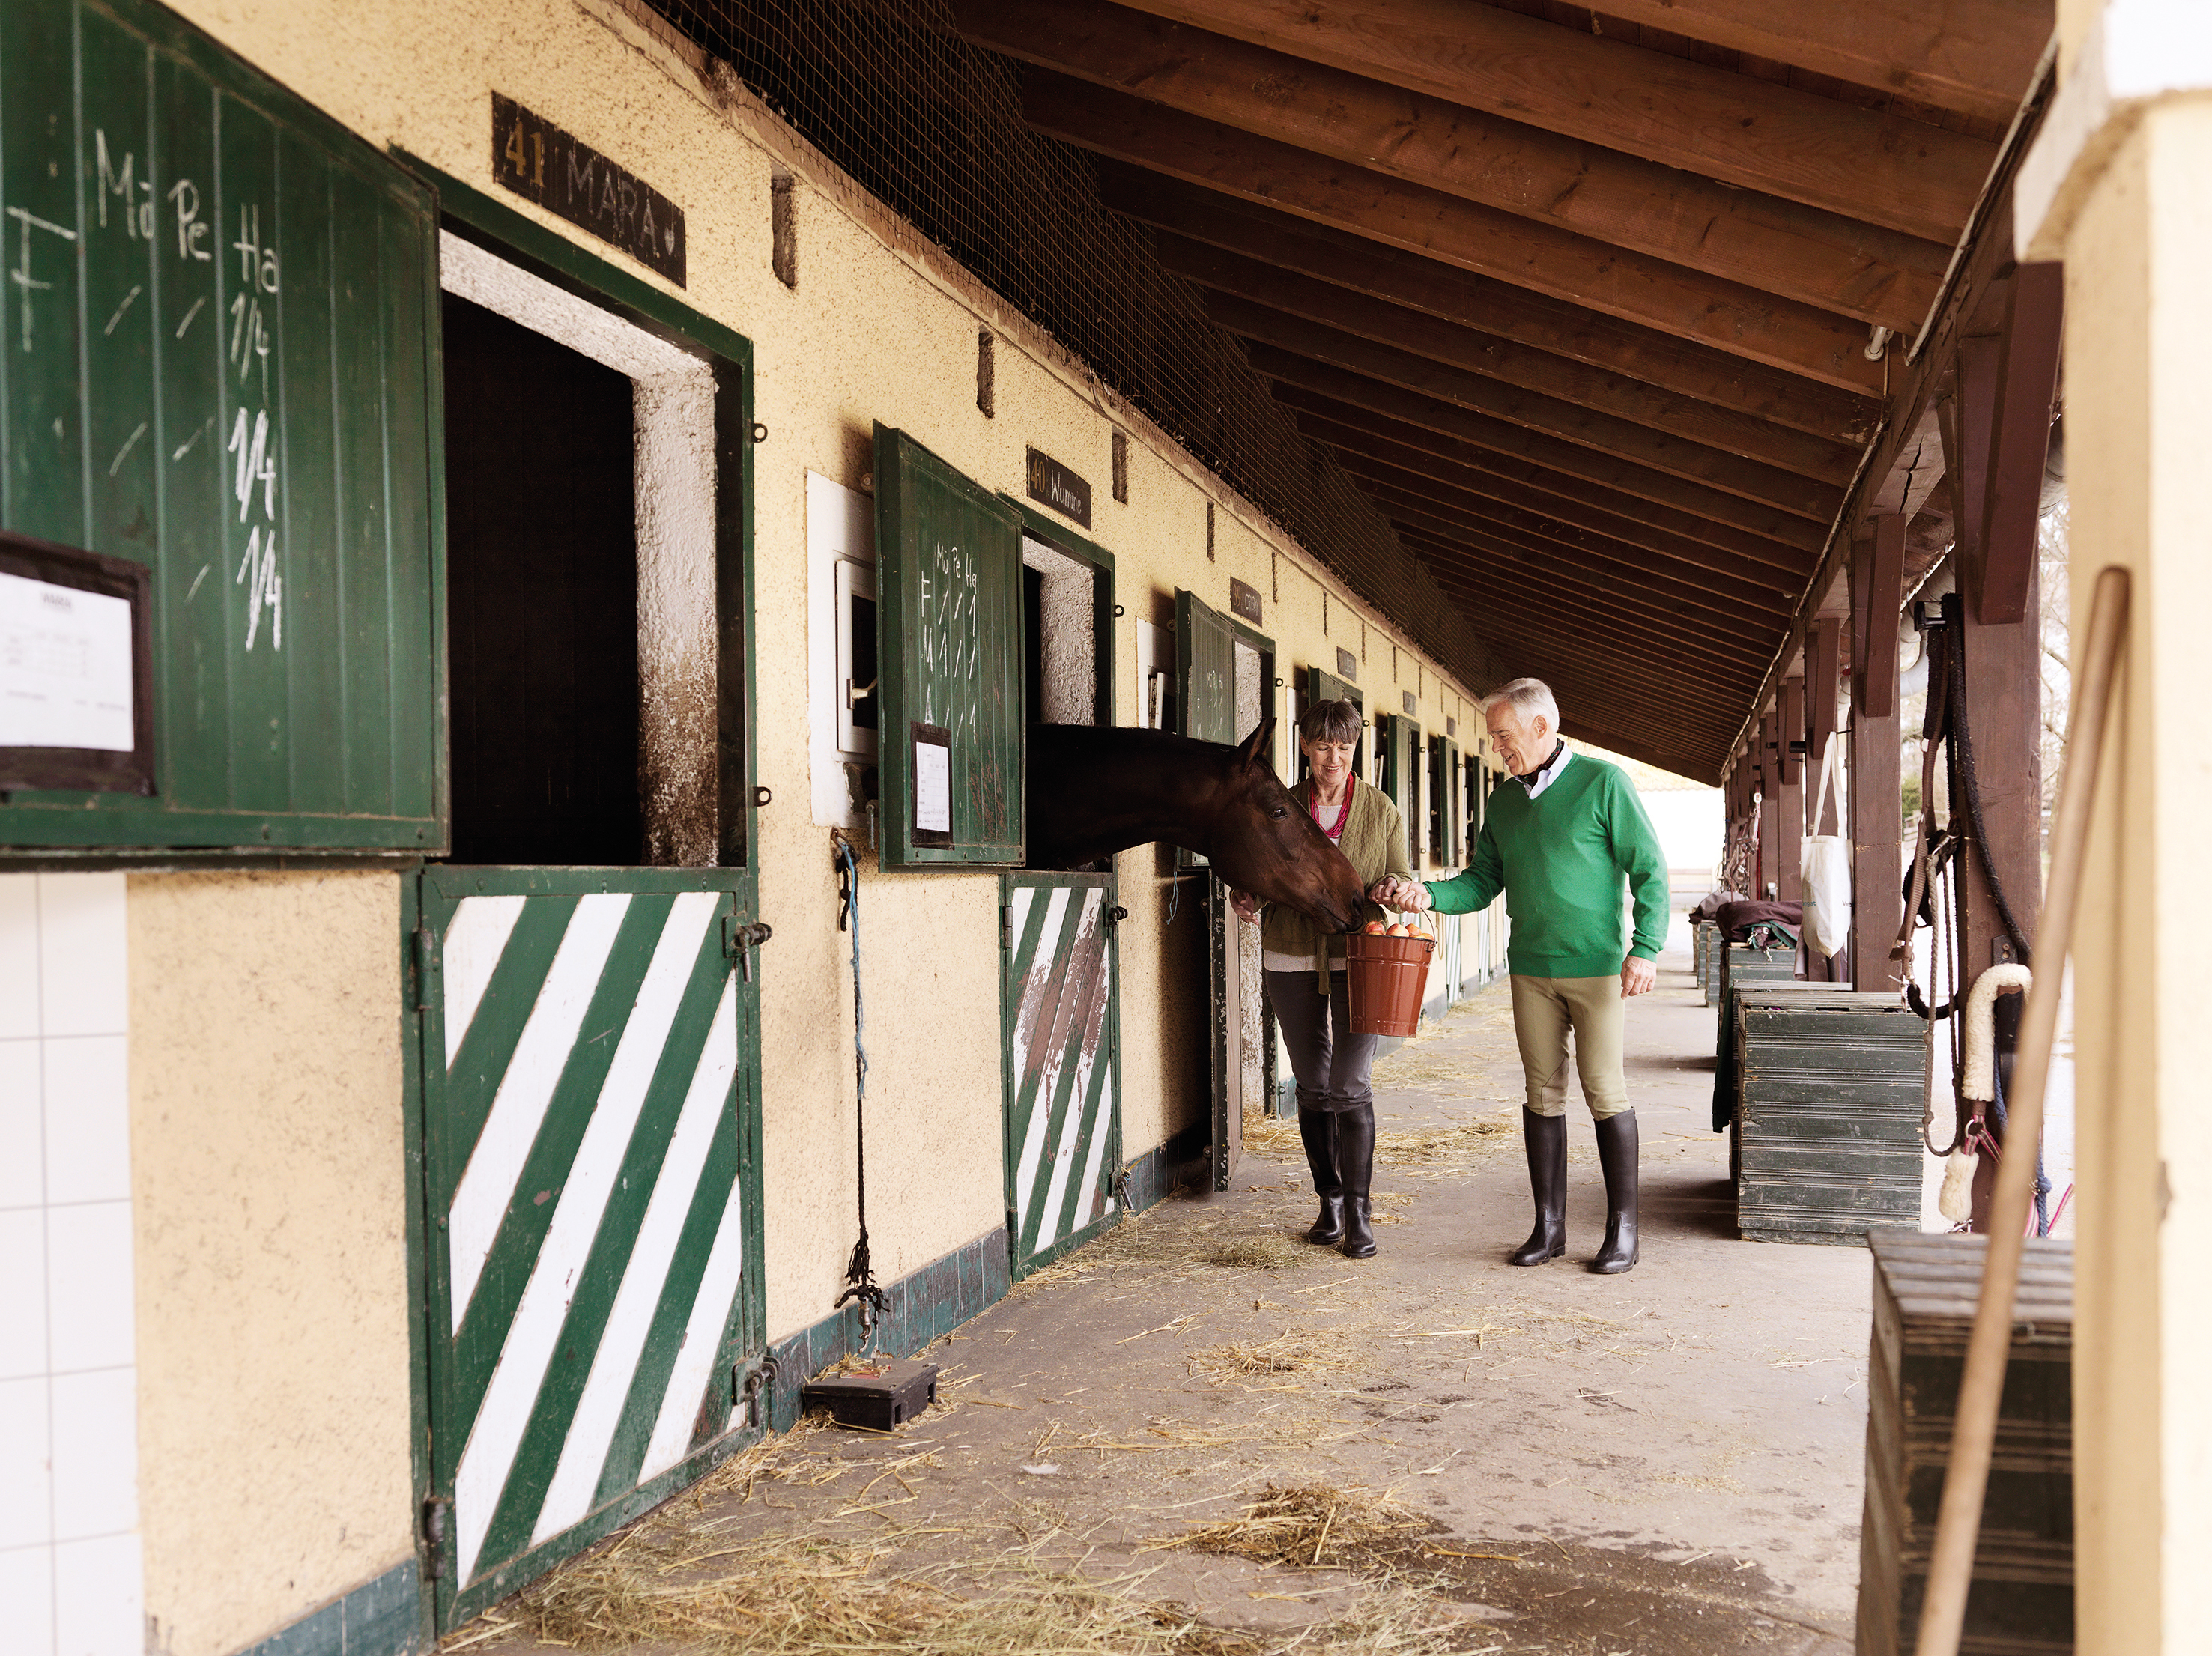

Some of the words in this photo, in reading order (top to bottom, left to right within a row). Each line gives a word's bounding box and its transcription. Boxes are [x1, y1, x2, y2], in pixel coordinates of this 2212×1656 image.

[505, 120, 546, 189] 41
[566, 149, 658, 256] MARA
[167, 178, 212, 261] Pe
[233, 203, 279, 295] Ha
[1031, 458, 1046, 493] 40
[921, 570, 931, 618] F
[951, 546, 961, 579] Pe
[965, 553, 977, 595] Ha
